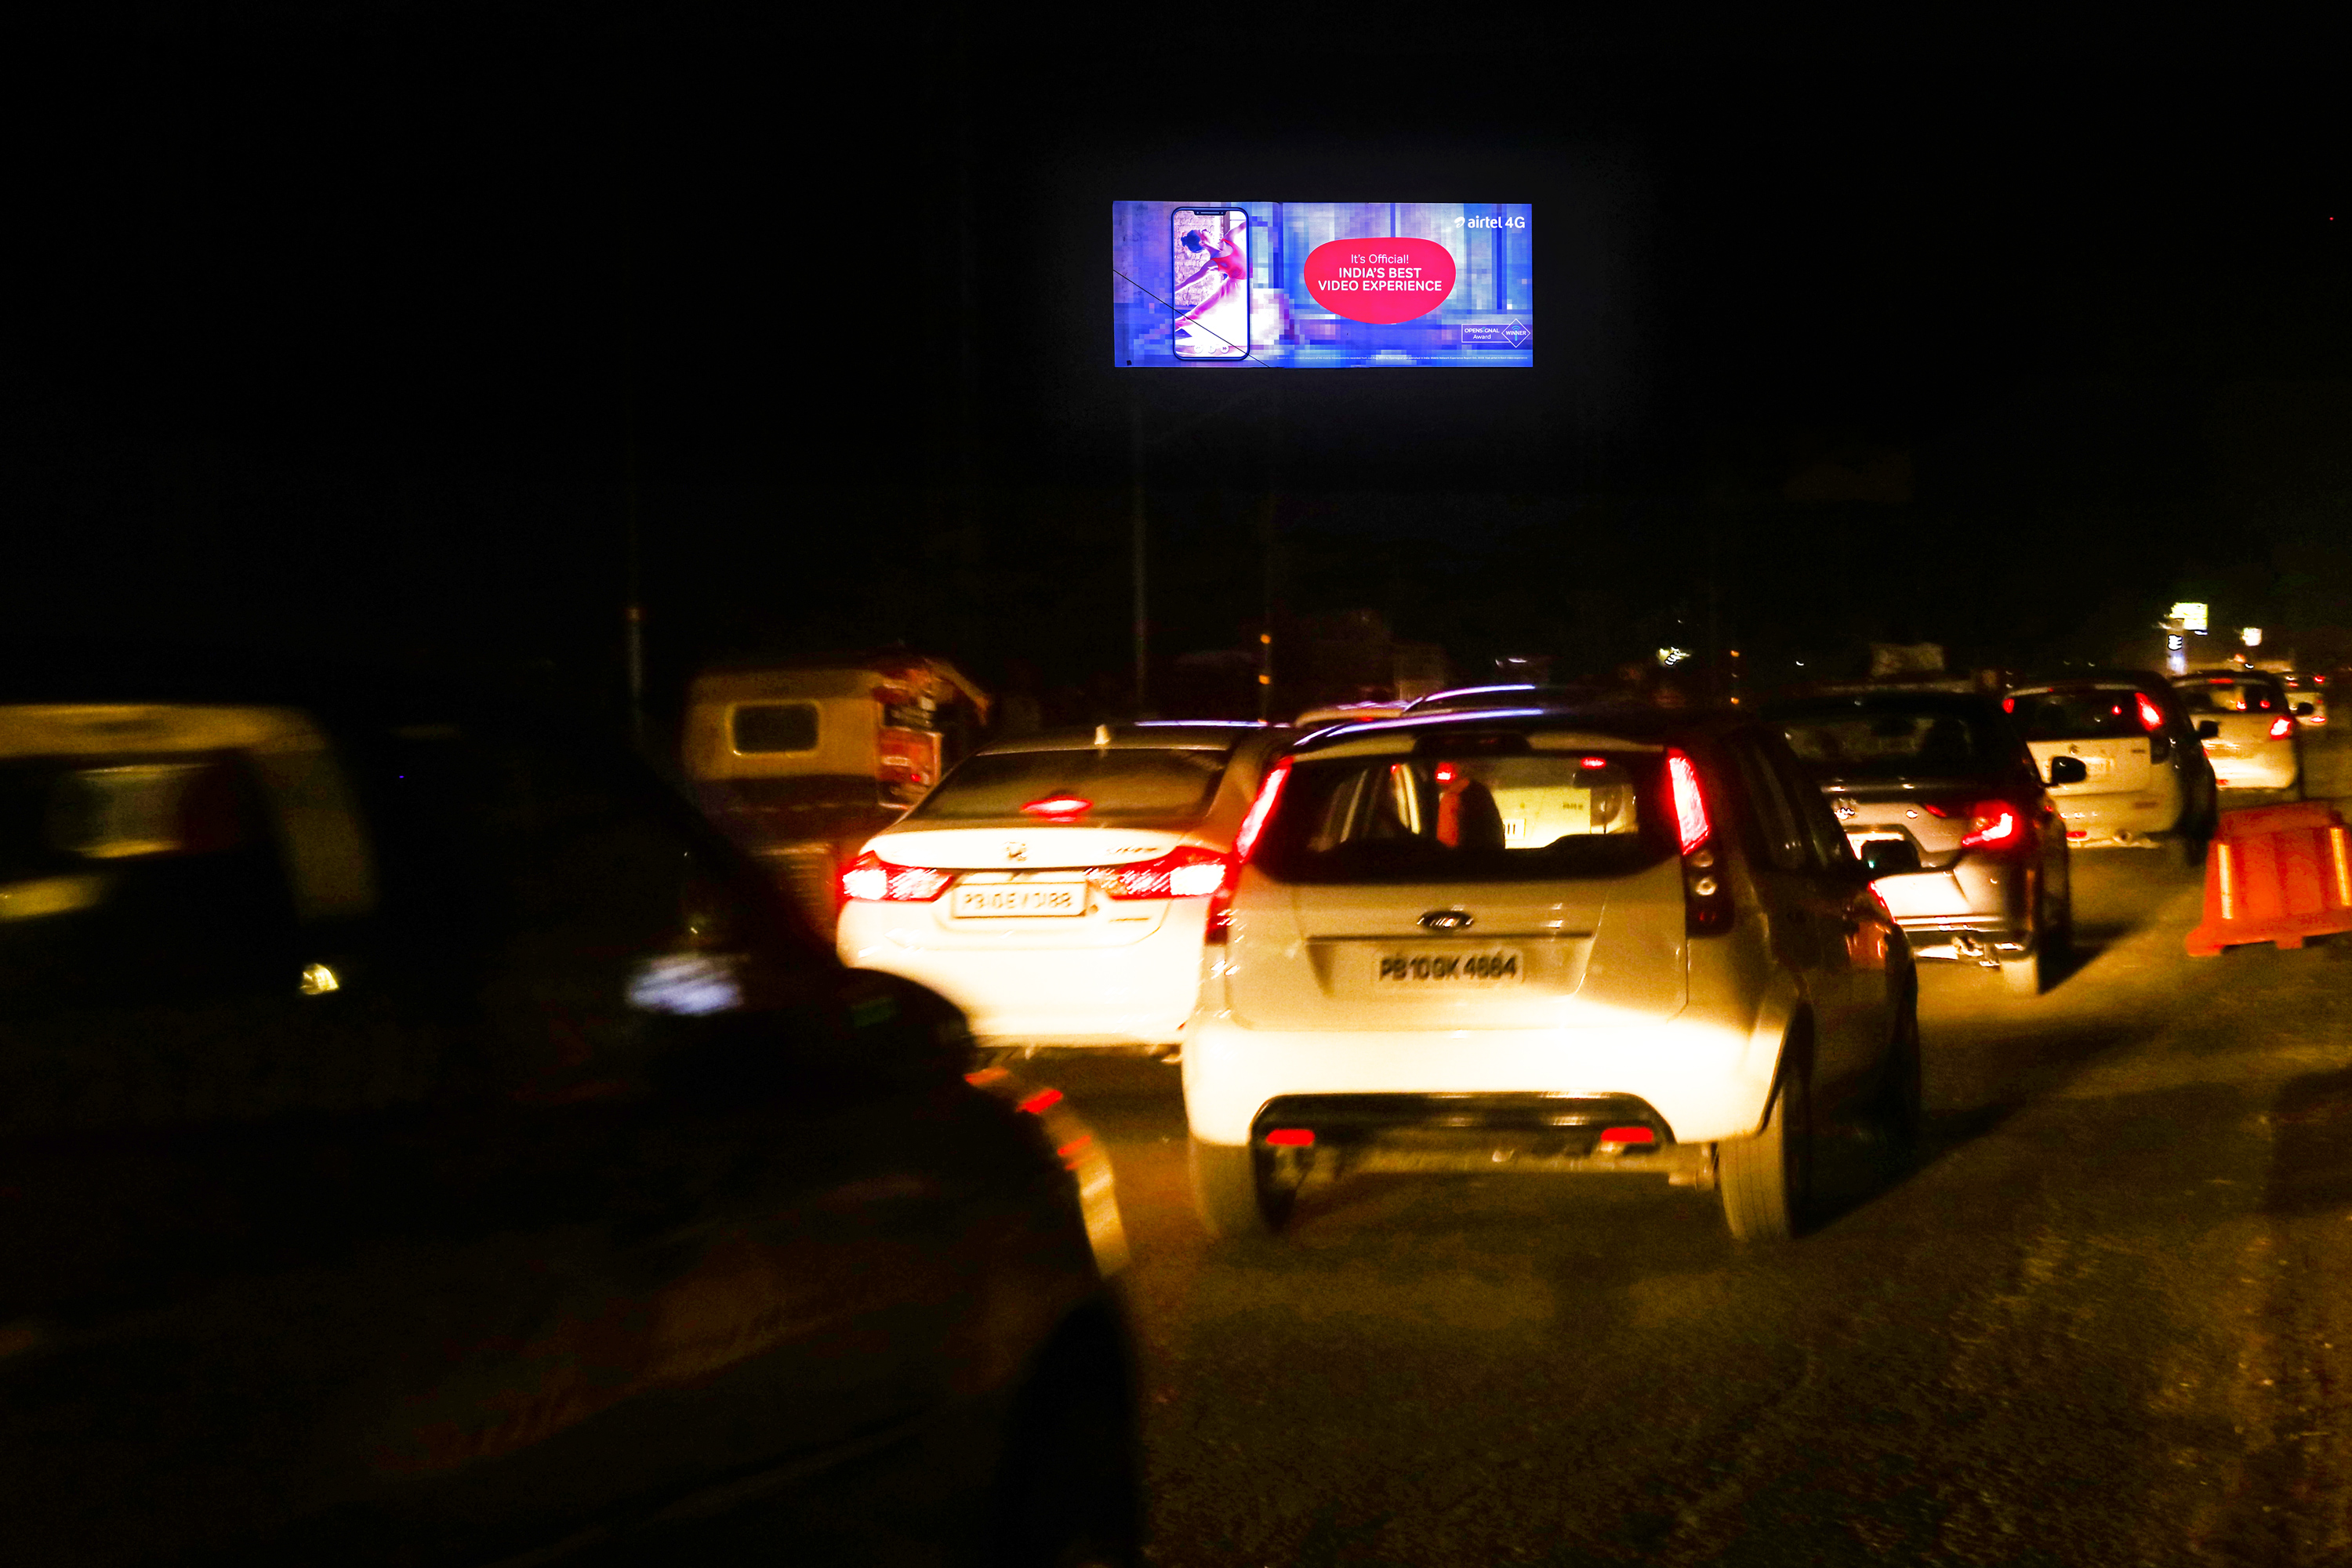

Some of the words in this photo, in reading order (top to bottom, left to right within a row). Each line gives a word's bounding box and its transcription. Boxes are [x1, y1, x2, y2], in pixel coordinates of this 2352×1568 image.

[1468, 215, 1502, 228] airtel
[1504, 216, 1525, 228] 4G
[1351, 254, 1366, 263] It's
[1369, 253, 1409, 263] Official!
[1339, 267, 1385, 278] INDIA'S
[1388, 267, 1421, 278] BEST
[1318, 280, 1359, 291] VIDEO
[1363, 280, 1442, 291] EXPERIENCE
